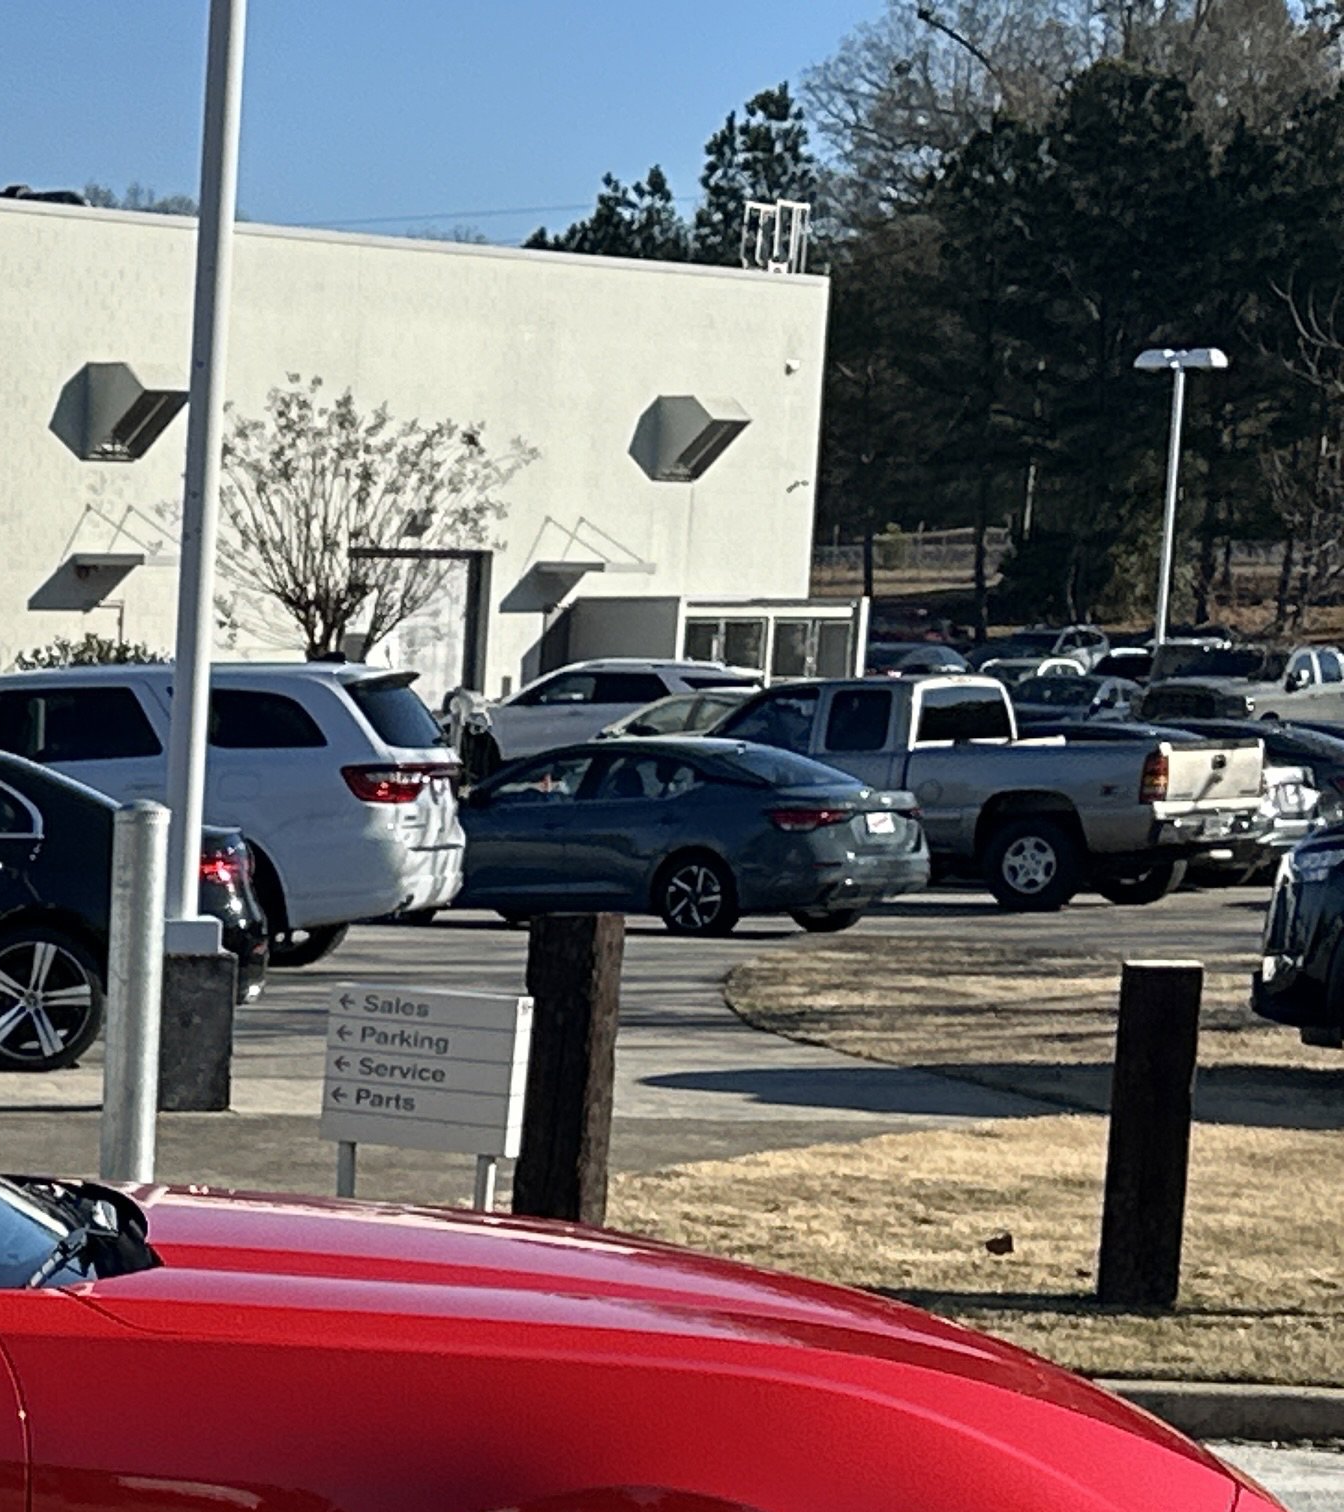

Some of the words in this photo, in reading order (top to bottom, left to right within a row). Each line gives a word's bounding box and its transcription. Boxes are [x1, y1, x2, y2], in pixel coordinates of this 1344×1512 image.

[363, 994, 431, 1018] Sales
[360, 1026, 450, 1055] Parking
[358, 1057, 446, 1083] Service
[355, 1088, 416, 1112] Parts
